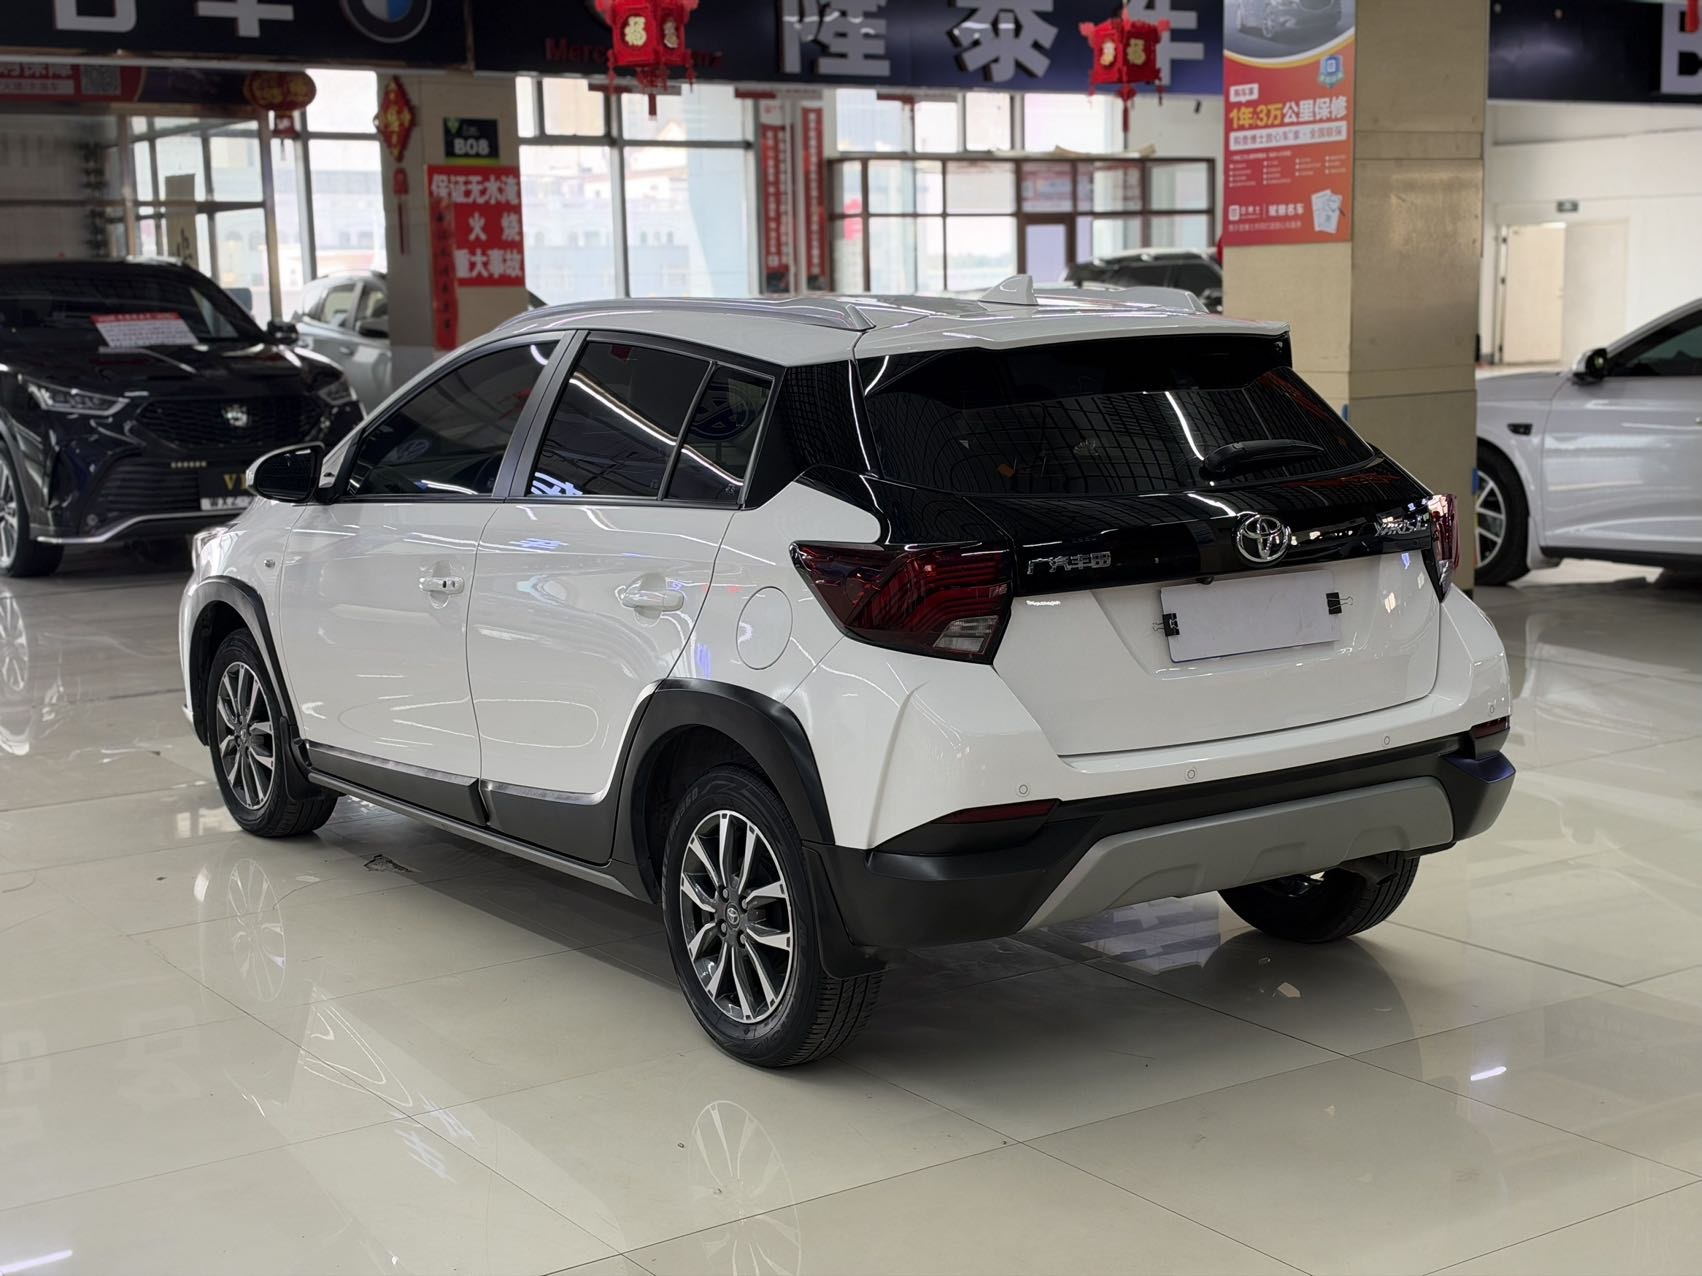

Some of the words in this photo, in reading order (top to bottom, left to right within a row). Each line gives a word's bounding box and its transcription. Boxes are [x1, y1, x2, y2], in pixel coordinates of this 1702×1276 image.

[453, 138, 489, 155] B08
[455, 248, 522, 279] 重大事故
